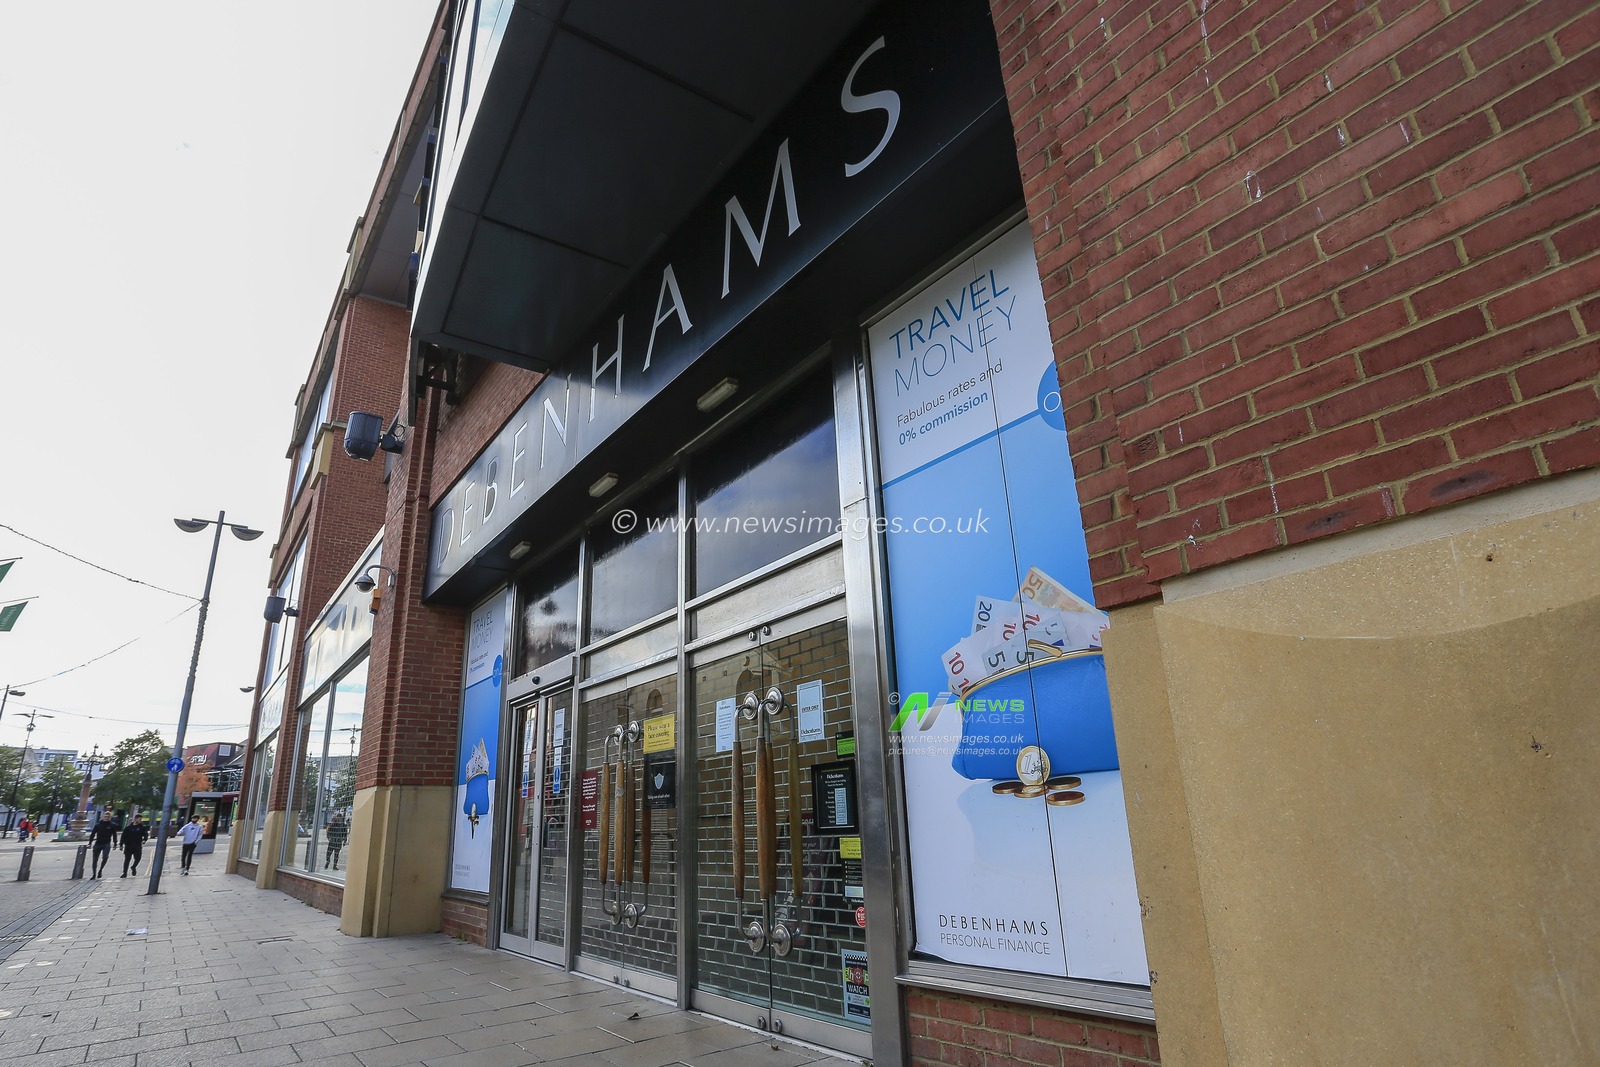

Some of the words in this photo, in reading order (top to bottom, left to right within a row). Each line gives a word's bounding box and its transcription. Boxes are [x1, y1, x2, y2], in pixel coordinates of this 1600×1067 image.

[436, 35, 901, 569] DEBENHAMS
[888, 268, 1010, 360] TRAVEL
[894, 294, 1017, 397] MONEY
[896, 393, 946, 428] Fabulous
[947, 376, 976, 400] rates
[979, 357, 1003, 383] and
[898, 427, 917, 446] 0%
[919, 391, 989, 436] commission
[977, 600, 993, 623] 20
[948, 651, 966, 676] 10
[987, 650, 1006, 668] 5
[1016, 650, 1035, 665] 5
[939, 914, 1049, 936] DEBENHAMS
[940, 932, 996, 950] PERSONAL
[998, 938, 1051, 956] FINANCE
[847, 984, 868, 996] WATCH
